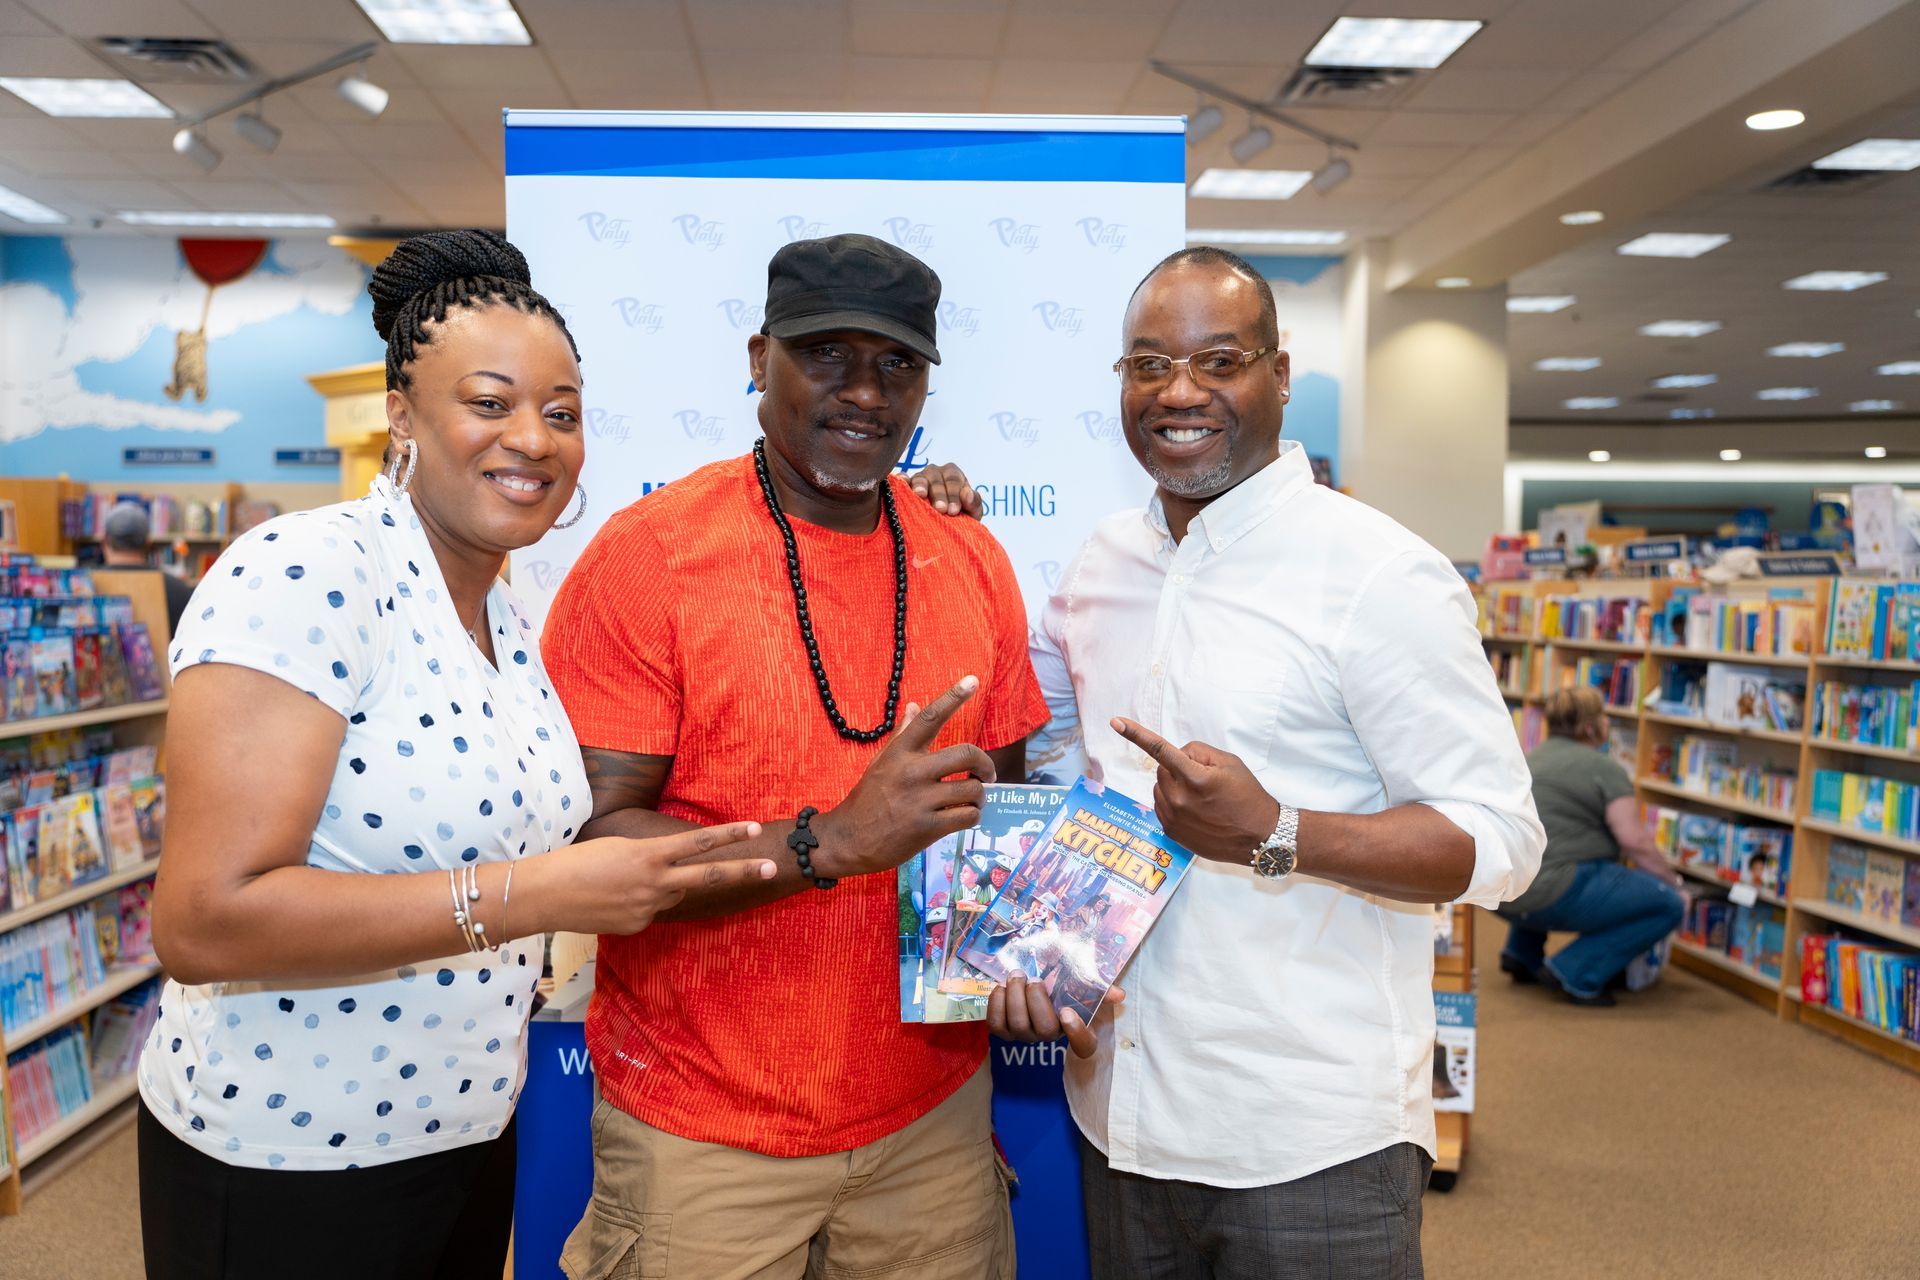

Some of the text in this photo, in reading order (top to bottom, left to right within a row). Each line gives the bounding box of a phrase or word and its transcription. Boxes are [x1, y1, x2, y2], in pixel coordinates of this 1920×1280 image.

[985, 791, 998, 803] st
[1001, 791, 1025, 804] Like
[1028, 792, 1046, 808] My
[1103, 802, 1165, 837] ELIZABETH JOHNSON
[1109, 813, 1132, 828] AUNTIE
[1072, 807, 1173, 868] MAMAW MEL'S
[1052, 818, 1168, 895] KITCHEN
[558, 1047, 595, 1076] W
[1001, 1041, 1068, 1067] with
